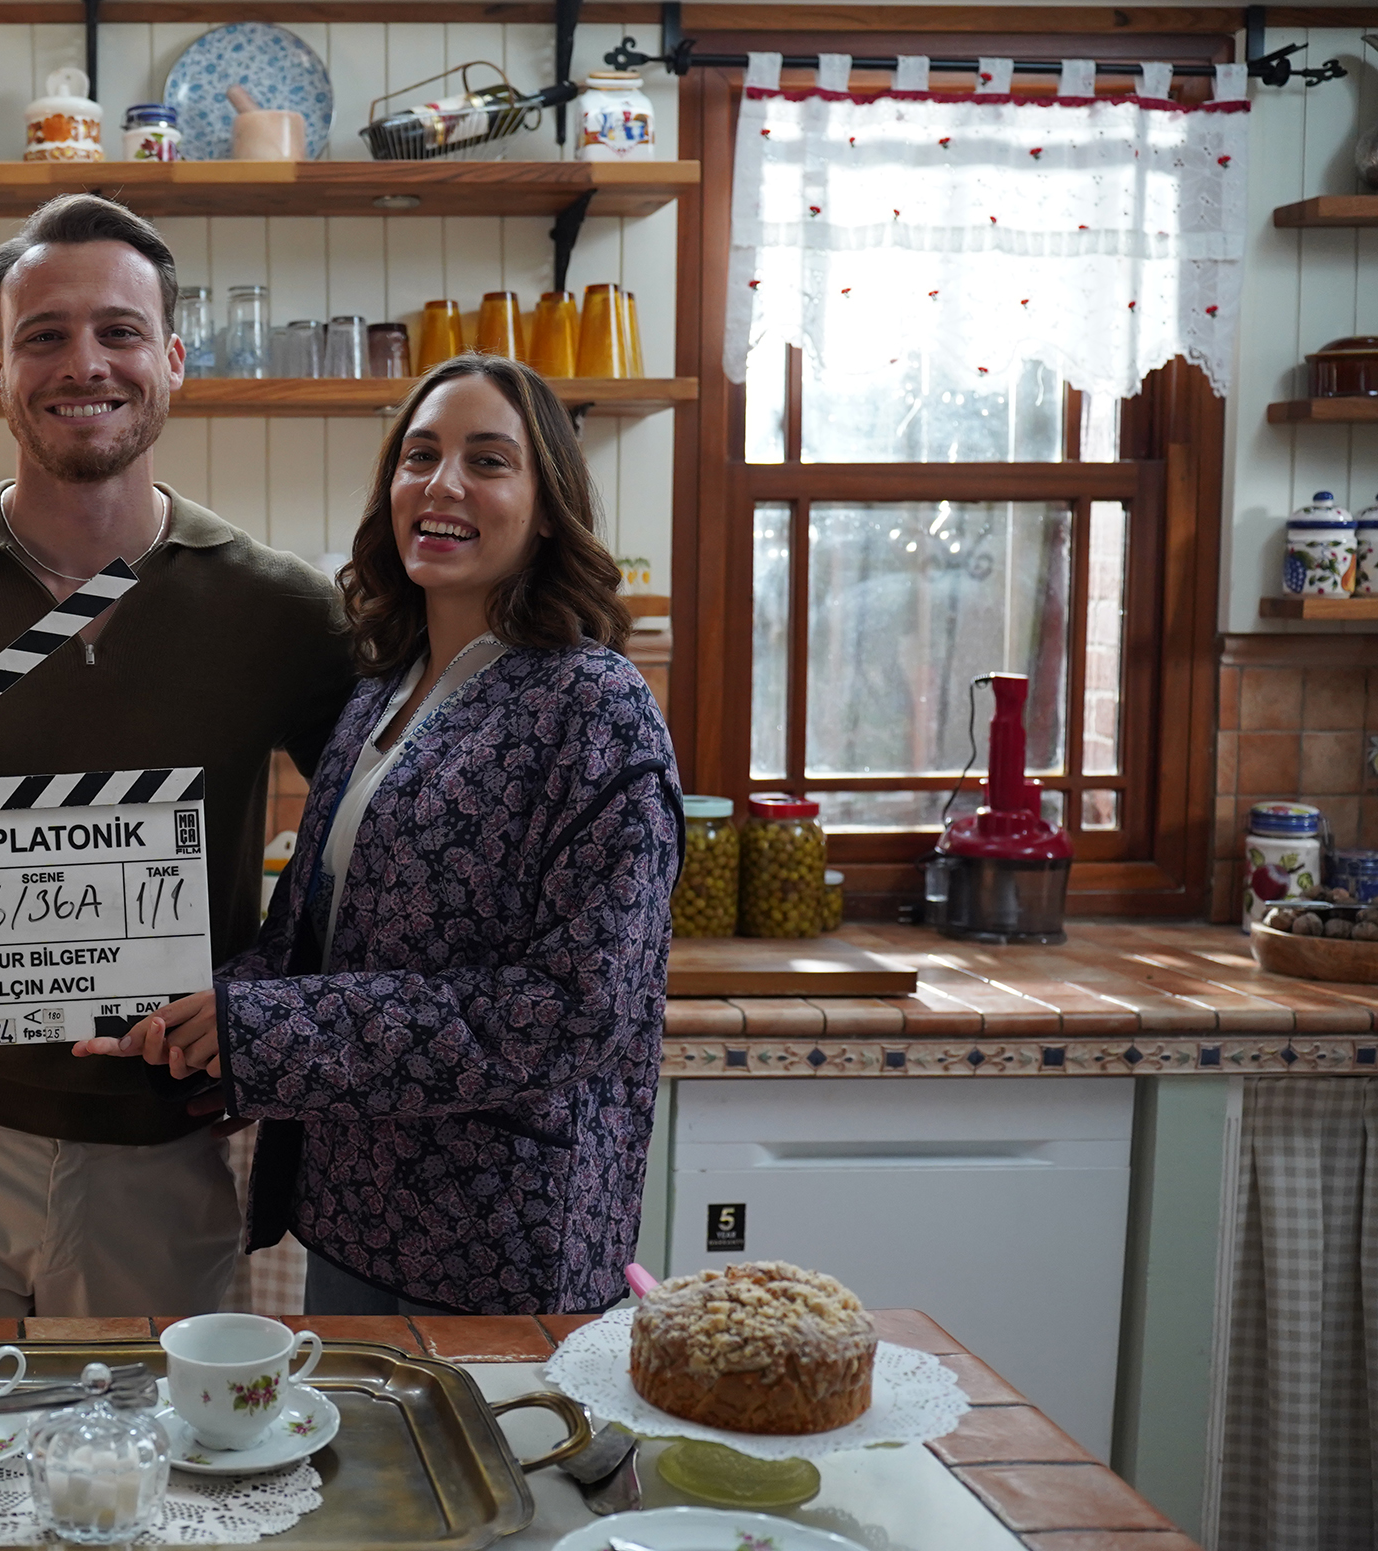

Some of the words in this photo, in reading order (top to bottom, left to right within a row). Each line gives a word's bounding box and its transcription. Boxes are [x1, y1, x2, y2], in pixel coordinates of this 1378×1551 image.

[176, 847, 201, 855] FILM
[22, 871, 65, 884] SCENE
[146, 866, 179, 877] TAKE
[30, 946, 121, 968] BİLGETAY
[49, 976, 95, 994] AVCI
[101, 1003, 121, 1015] INT
[136, 1001, 161, 1013] DAY
[718, 1207, 735, 1231] 5
